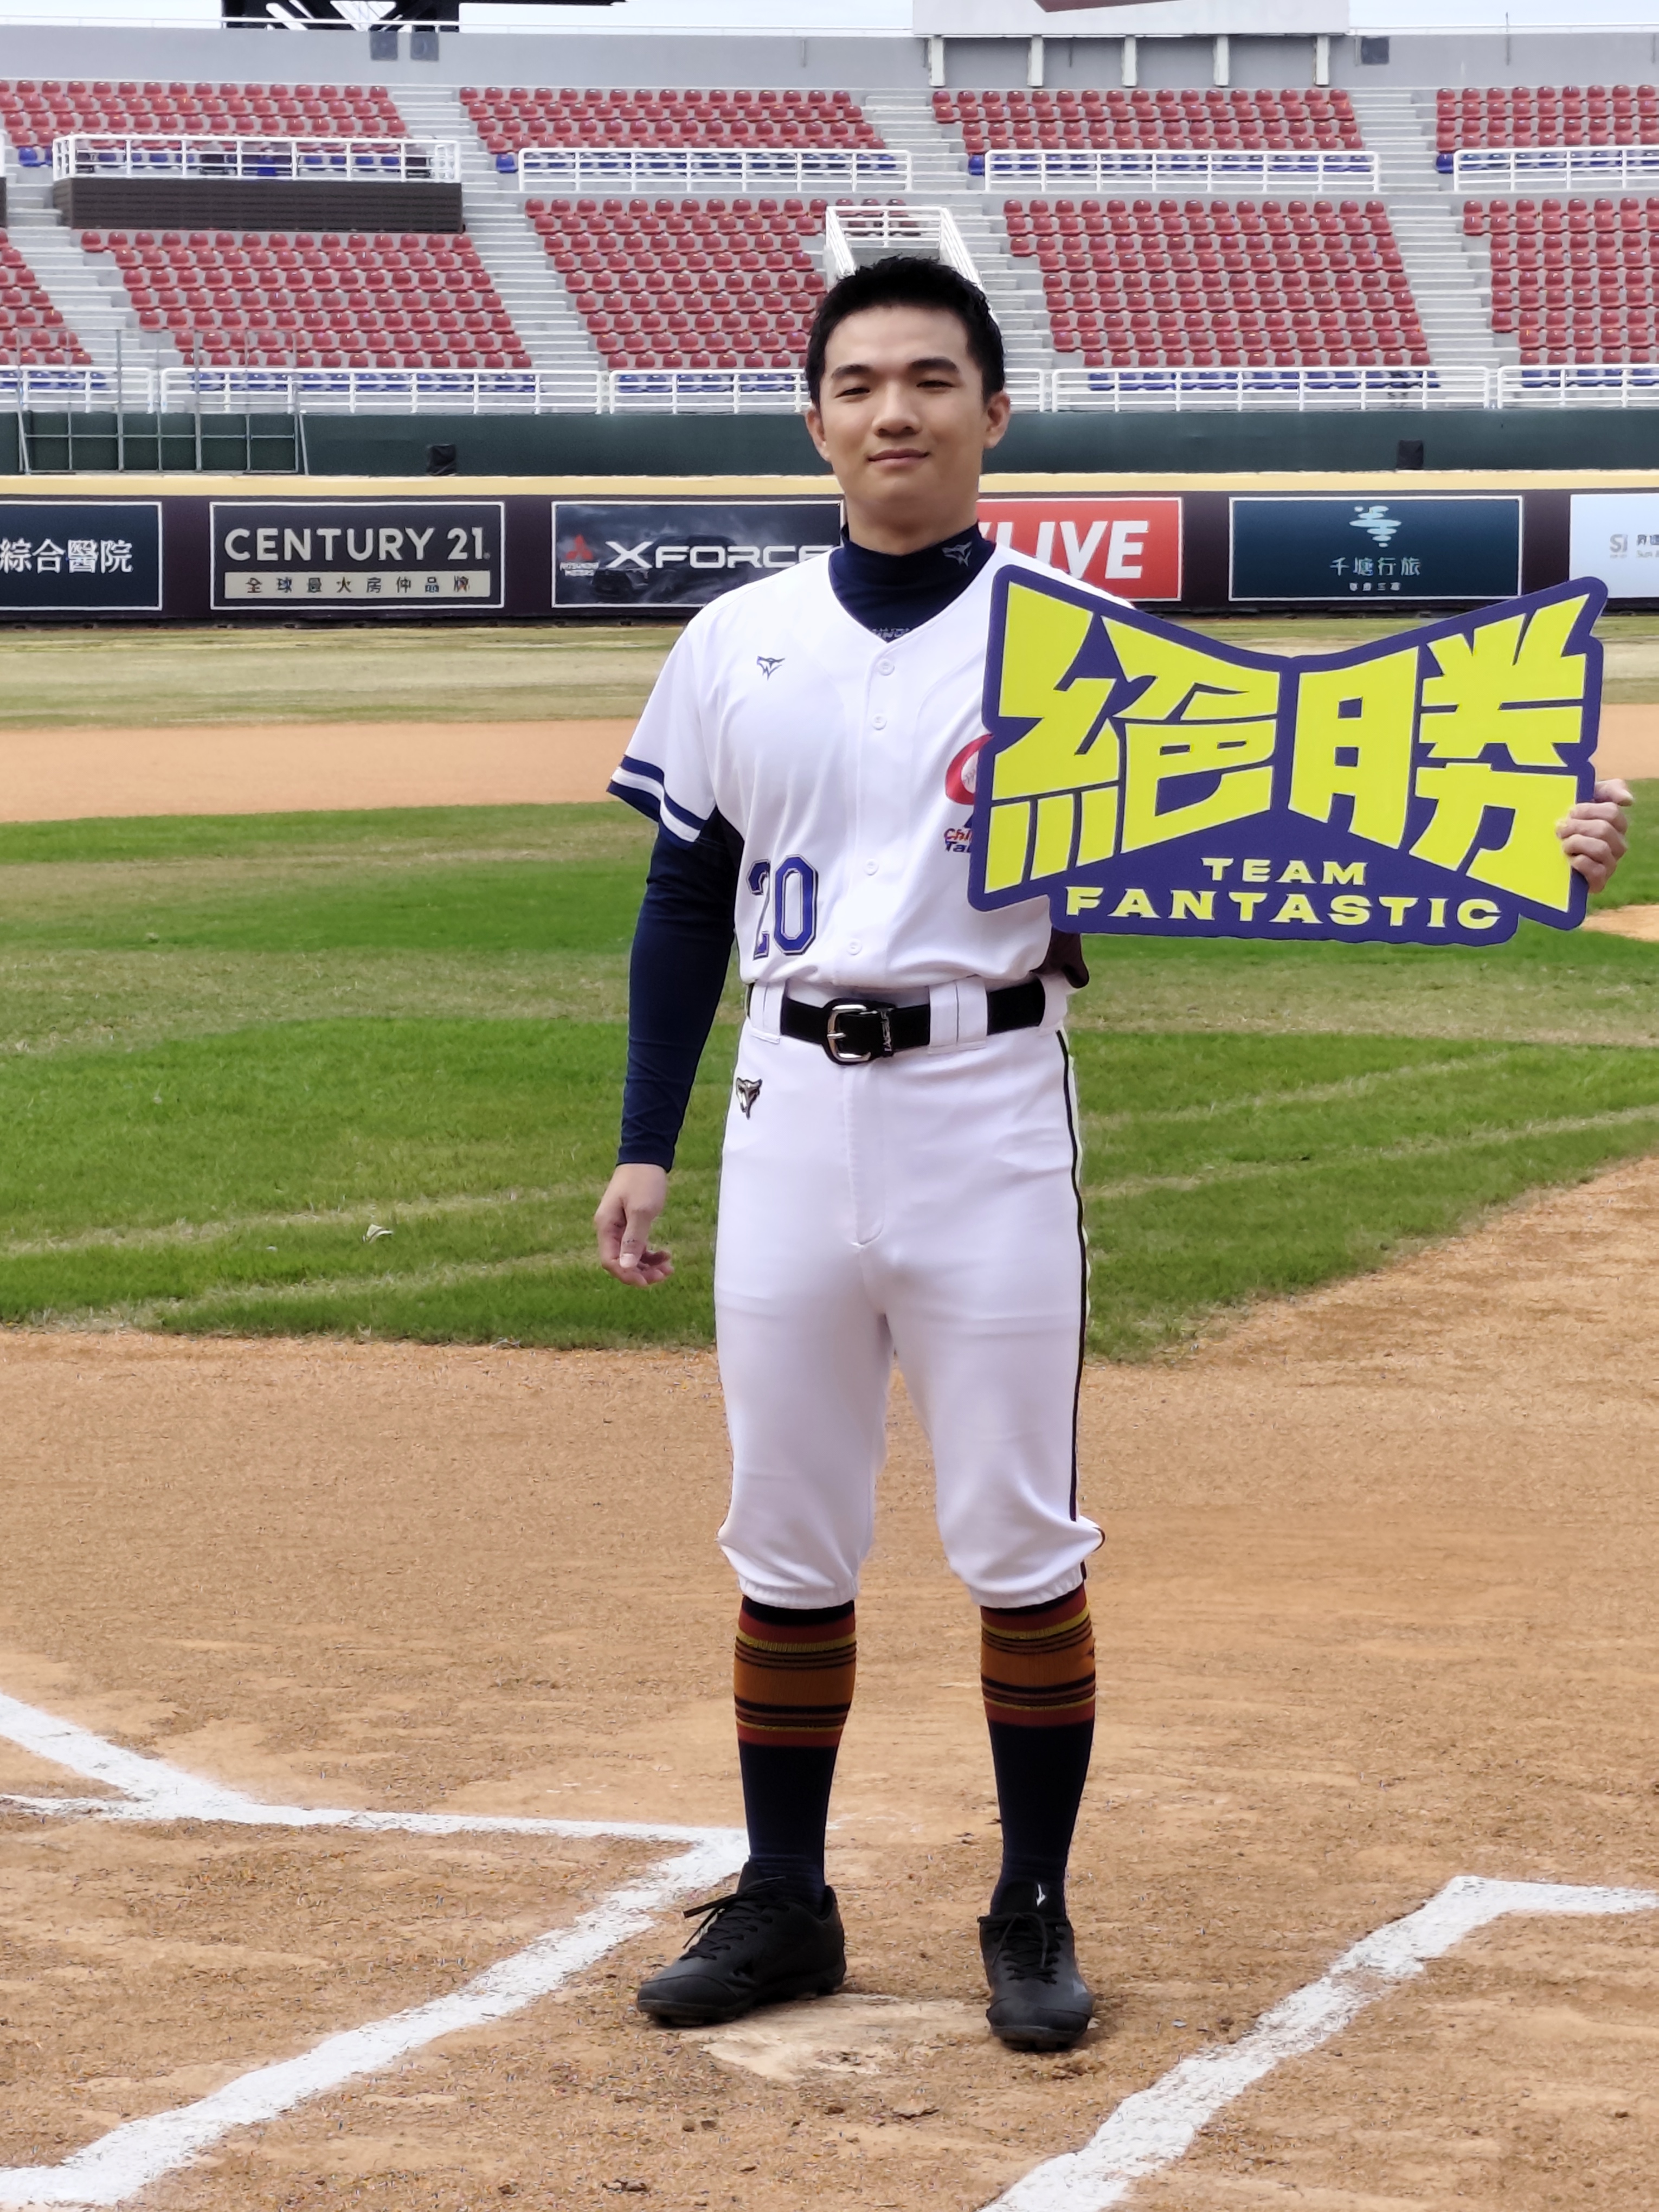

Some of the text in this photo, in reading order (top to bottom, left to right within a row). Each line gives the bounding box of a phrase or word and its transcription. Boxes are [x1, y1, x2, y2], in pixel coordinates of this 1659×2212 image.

[0, 538, 133, 574] 綜合醫院
[224, 527, 483, 561] CENTURY 21
[1201, 858, 1368, 886] TEAM
[746, 854, 819, 960] 20
[1065, 886, 1502, 929] FANTASTIC
